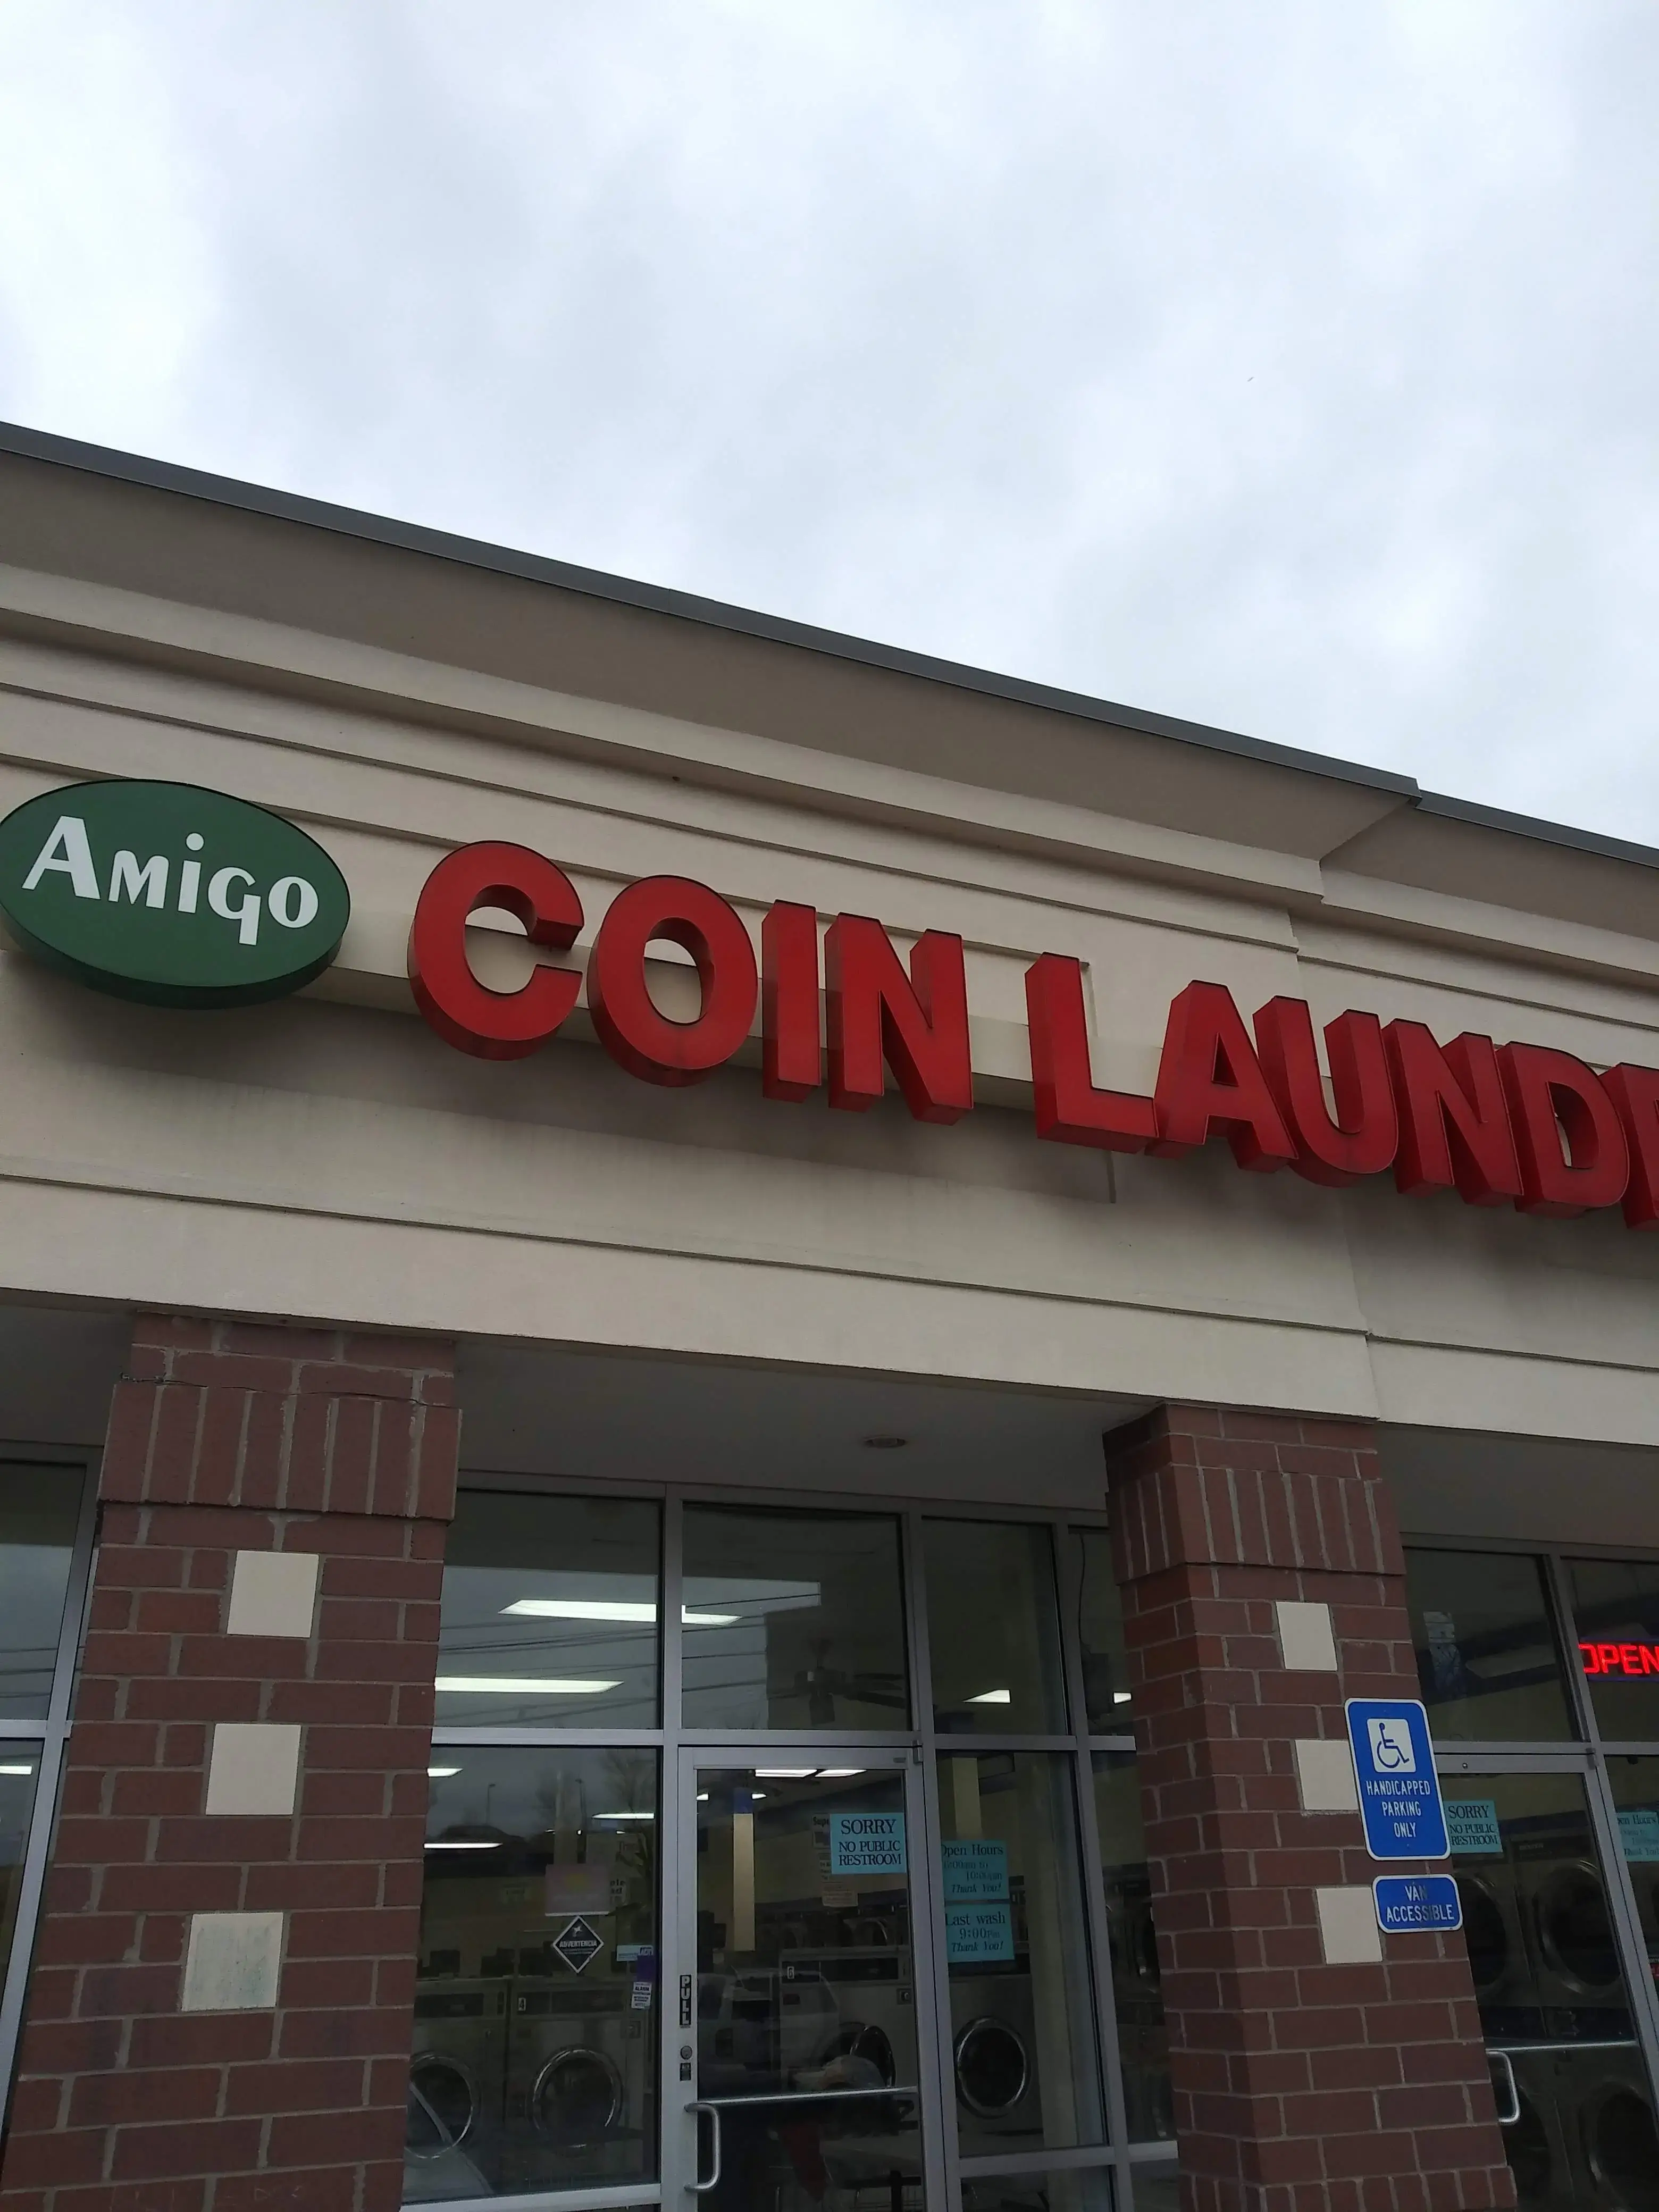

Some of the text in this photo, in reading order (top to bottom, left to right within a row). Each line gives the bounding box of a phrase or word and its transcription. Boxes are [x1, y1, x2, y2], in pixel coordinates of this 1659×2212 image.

[21, 815, 319, 946] Amigo
[408, 840, 974, 1126] COIN
[1365, 1780, 1431, 1796] HANDICAPPED
[1381, 1801, 1421, 1816] PARKING
[1448, 1805, 1489, 1819] SORRY
[841, 1819, 896, 1834] SORRY
[1394, 1822, 1417, 1838] ONLY
[1449, 1823, 1495, 1834] NO PUBLIC
[839, 1840, 901, 1853] NO PUBLIC
[1451, 1835, 1498, 1846] RESTROOM
[972, 1844, 1003, 1855] Hours
[839, 1854, 901, 1866] RESTROOM
[951, 1882, 1001, 1893] Thank You!
[1404, 1886, 1428, 1901] VAN
[945, 1911, 1006, 1926] Last wash
[1386, 1904, 1454, 1923] ACCESSIBLE
[951, 1941, 1004, 1953] Thank You!
[681, 1975, 691, 2025] PULL
